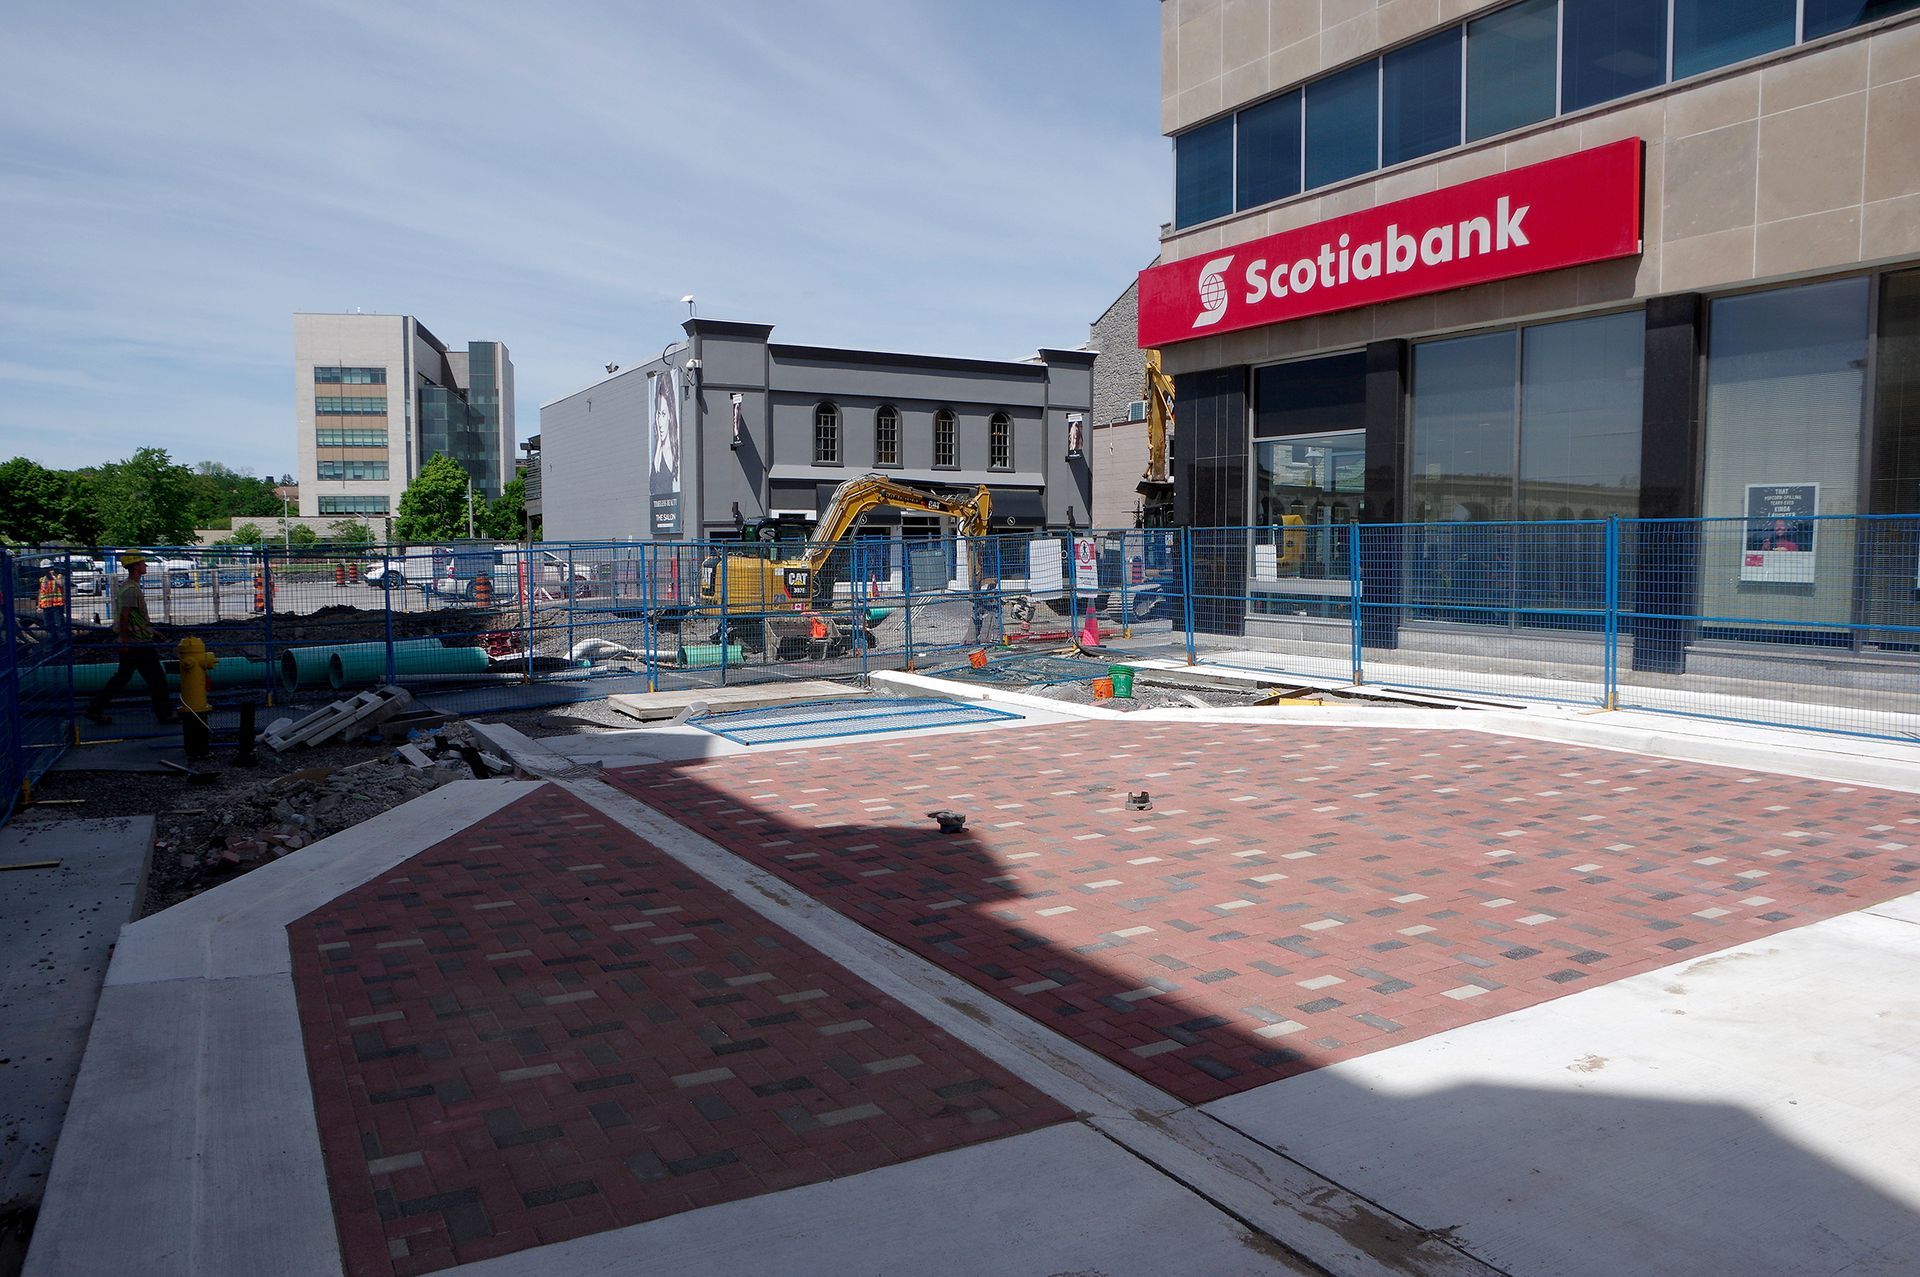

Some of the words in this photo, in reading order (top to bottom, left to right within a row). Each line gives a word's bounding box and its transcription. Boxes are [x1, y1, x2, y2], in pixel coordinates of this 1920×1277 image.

[1246, 196, 1531, 304] Scotiabank
[928, 500, 941, 510] CAT
[788, 572, 808, 585] CAT
